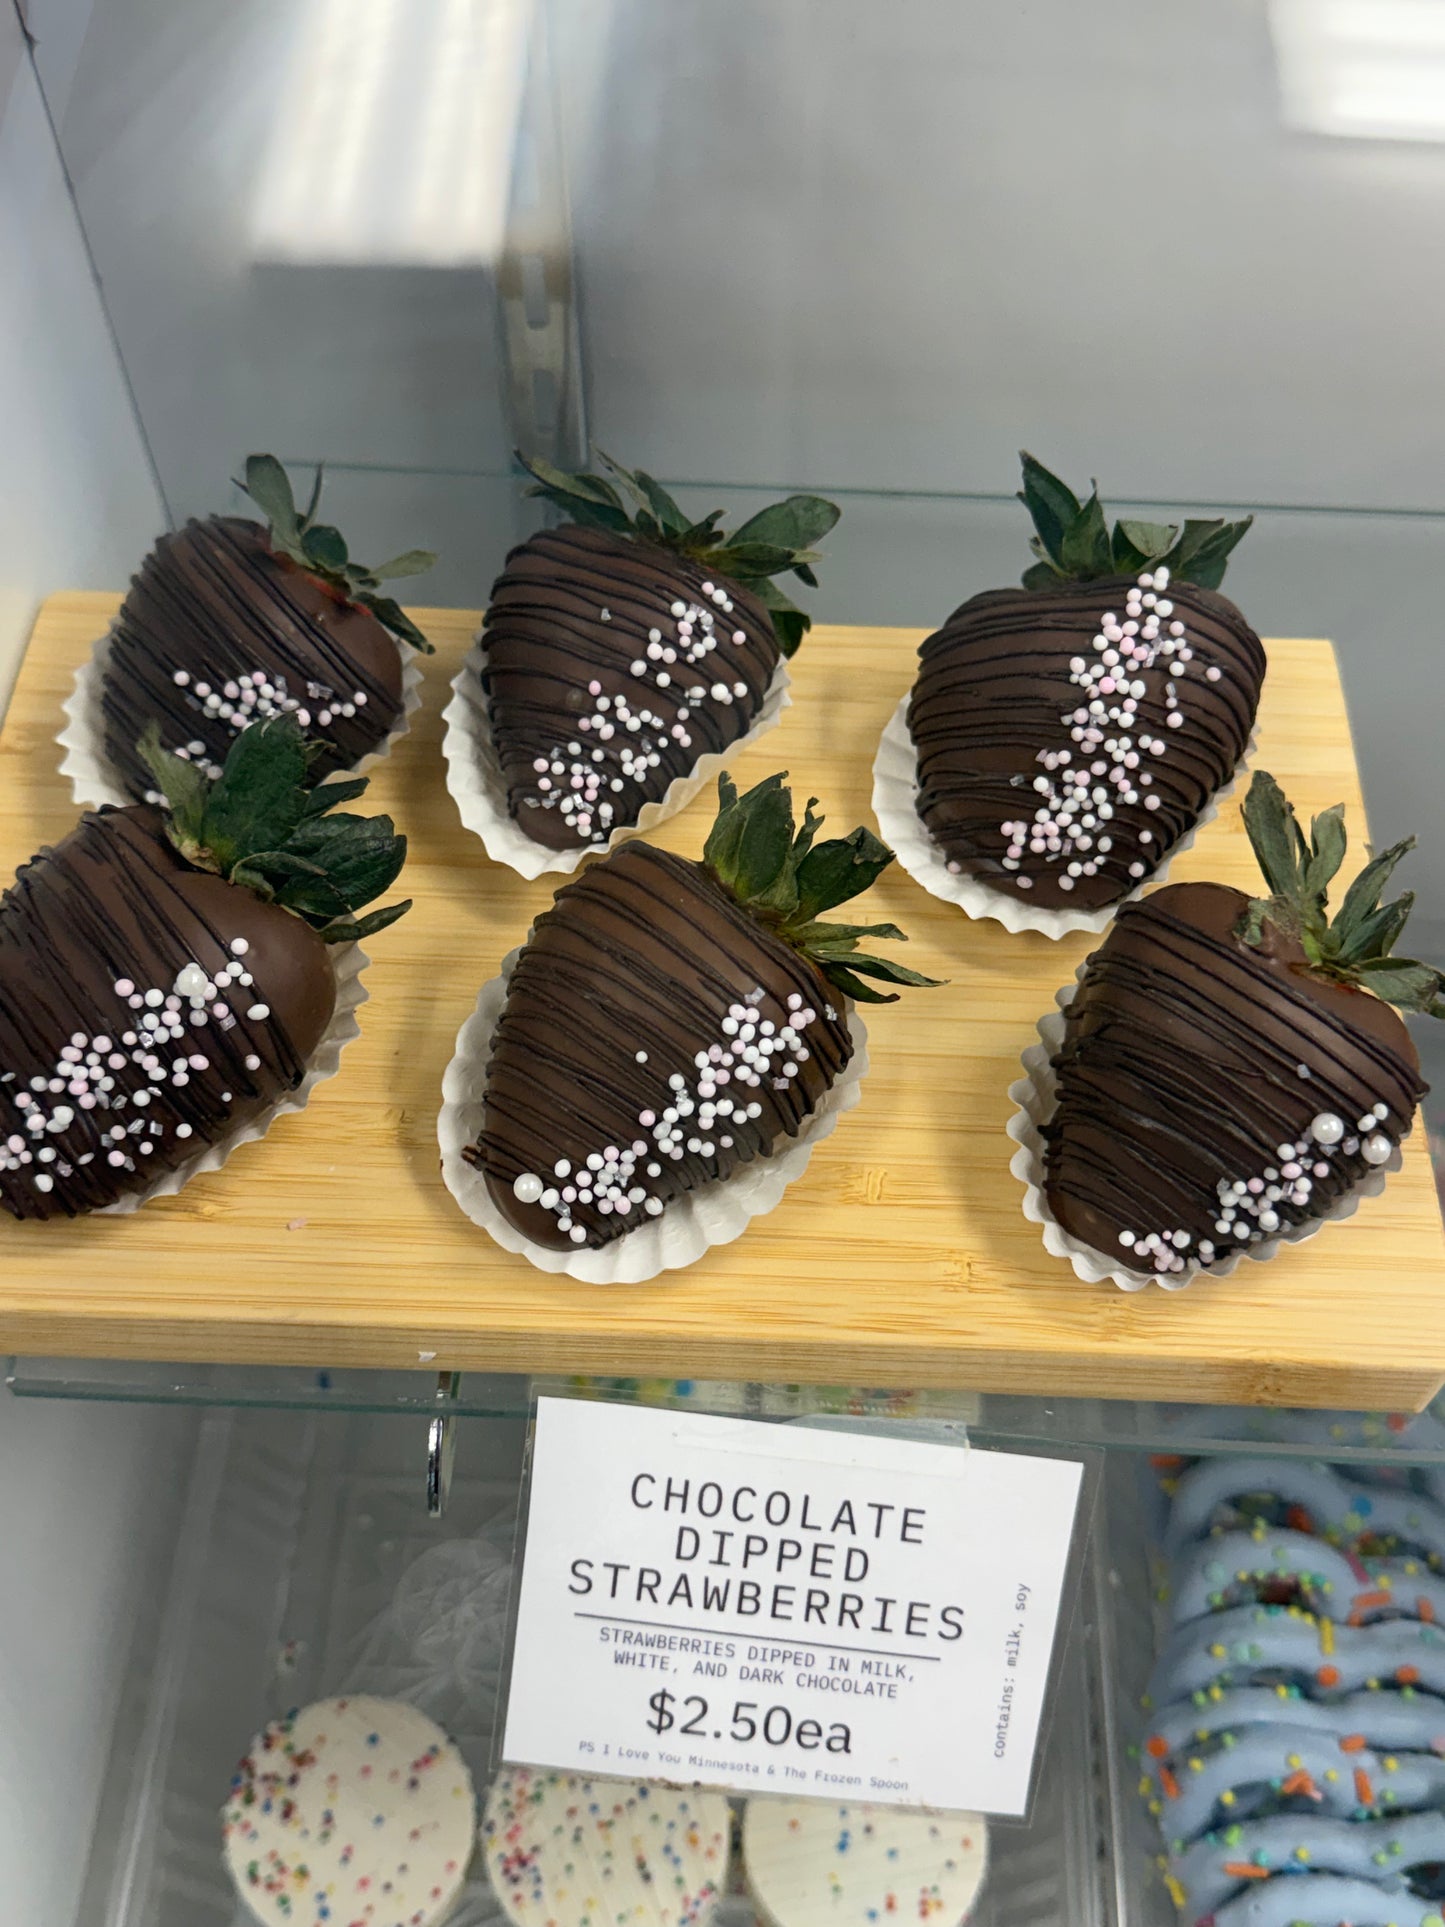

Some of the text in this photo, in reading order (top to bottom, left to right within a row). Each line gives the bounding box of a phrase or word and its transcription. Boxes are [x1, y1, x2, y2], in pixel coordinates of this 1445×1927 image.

[631, 1473, 926, 1544] CHOCOLATE
[675, 1526, 869, 1583] DIPPED
[568, 1559, 965, 1641] STRAWBERRIES
[600, 1627, 913, 1682] STRAWBERRIES DIPPED IN MILK,
[614, 1650, 898, 1699] WHITE, AND DARK CHOCOLATE
[994, 1584, 1031, 1758] contains: milk, soy
[646, 1688, 852, 1754] $2.50ea
[579, 1740, 909, 1790] PS I Love You Minnesota & The Frozen Spoon
